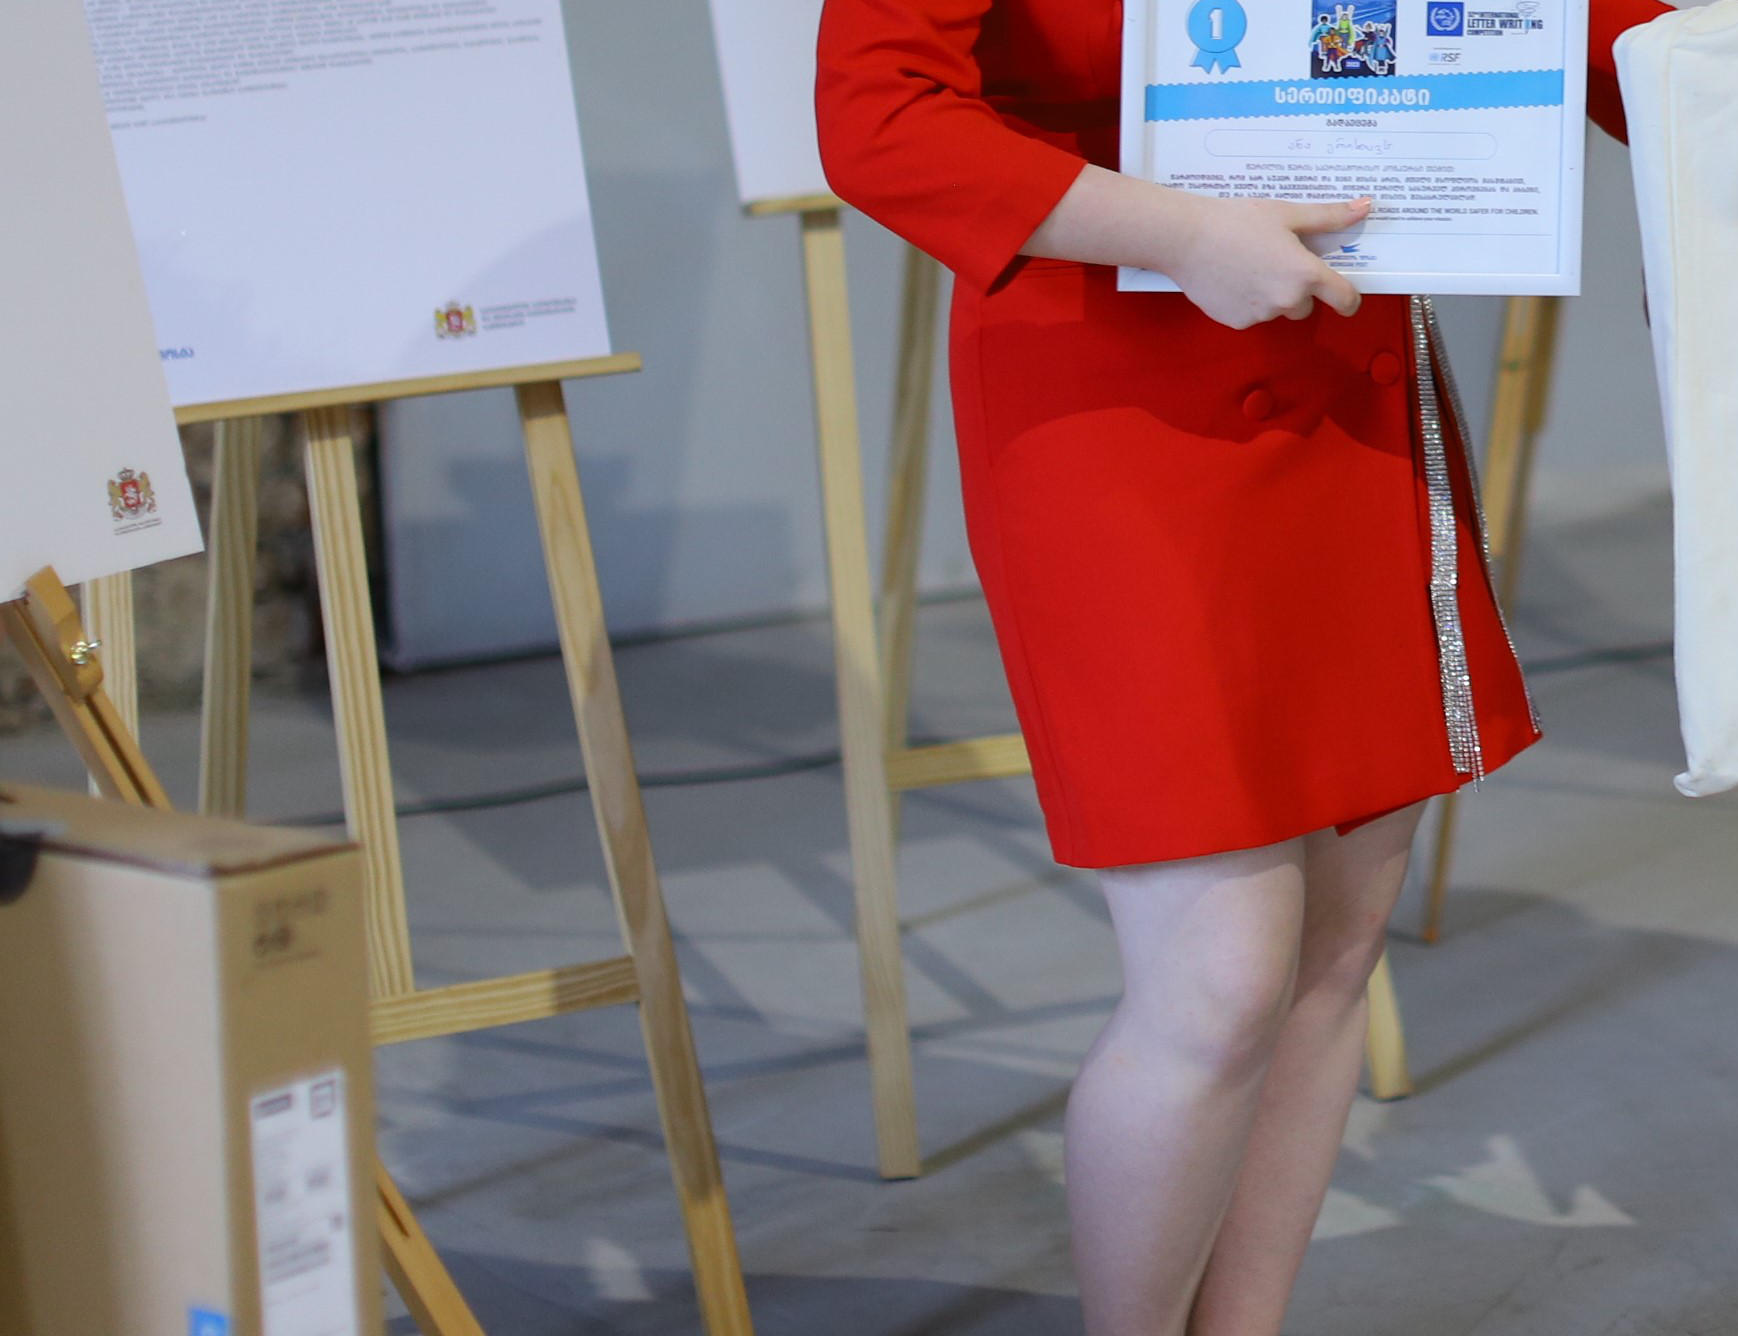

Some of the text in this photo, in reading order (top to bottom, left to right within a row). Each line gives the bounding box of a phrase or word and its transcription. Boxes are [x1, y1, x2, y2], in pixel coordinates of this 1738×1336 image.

[1209, 8, 1223, 40] 1
[1467, 18, 1496, 28] LETTER
[1274, 86, 1430, 105] სერთიფიკატი
